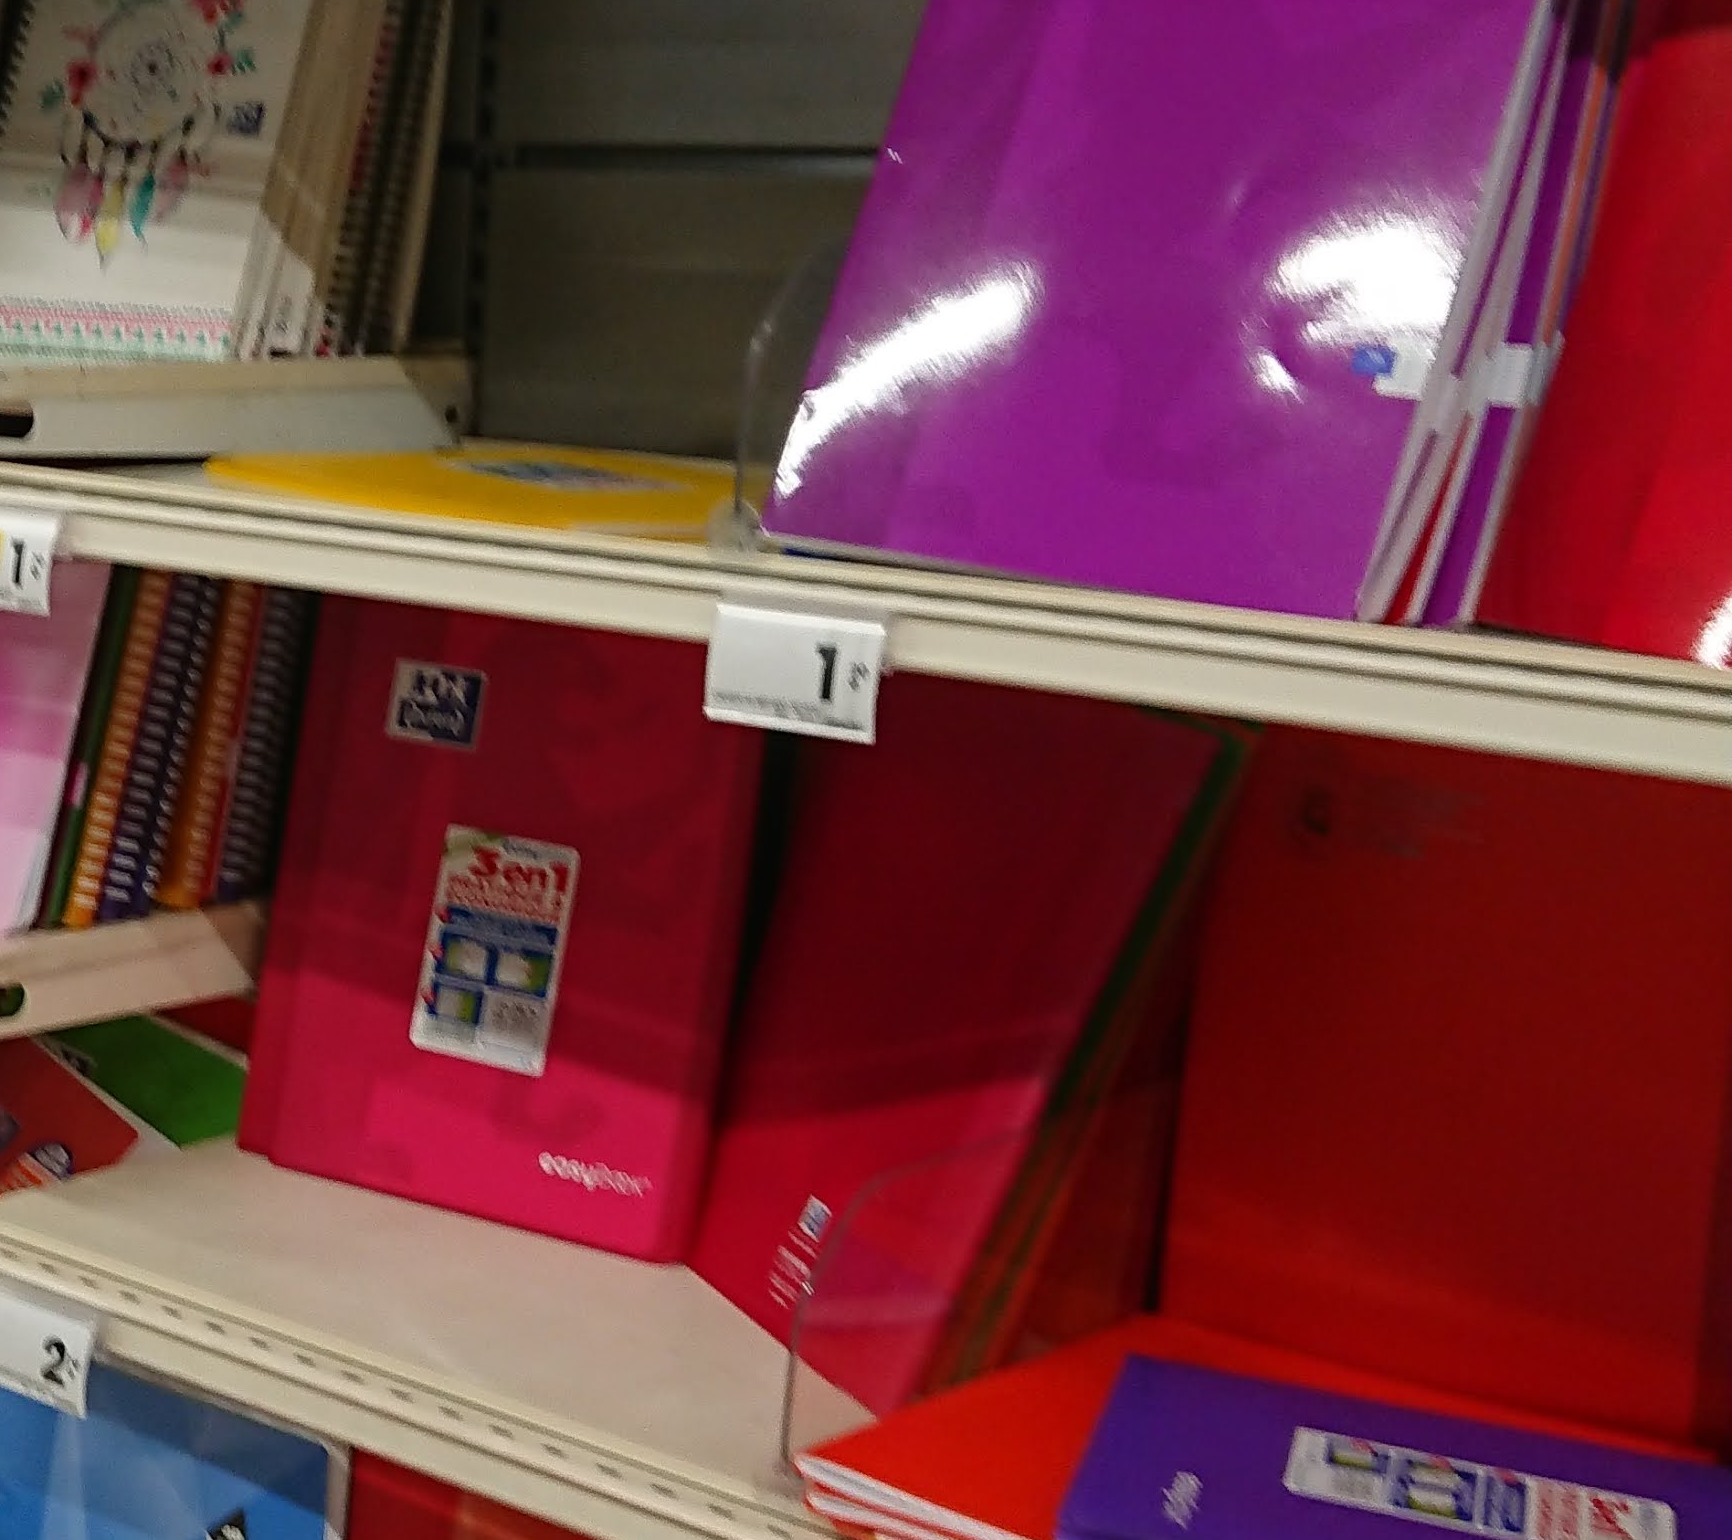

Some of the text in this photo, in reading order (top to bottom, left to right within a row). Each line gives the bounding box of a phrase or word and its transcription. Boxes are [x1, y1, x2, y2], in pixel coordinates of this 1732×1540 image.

[10, 537, 25, 591] 1
[817, 644, 838, 702] 1
[40, 1334, 66, 1388] 2
